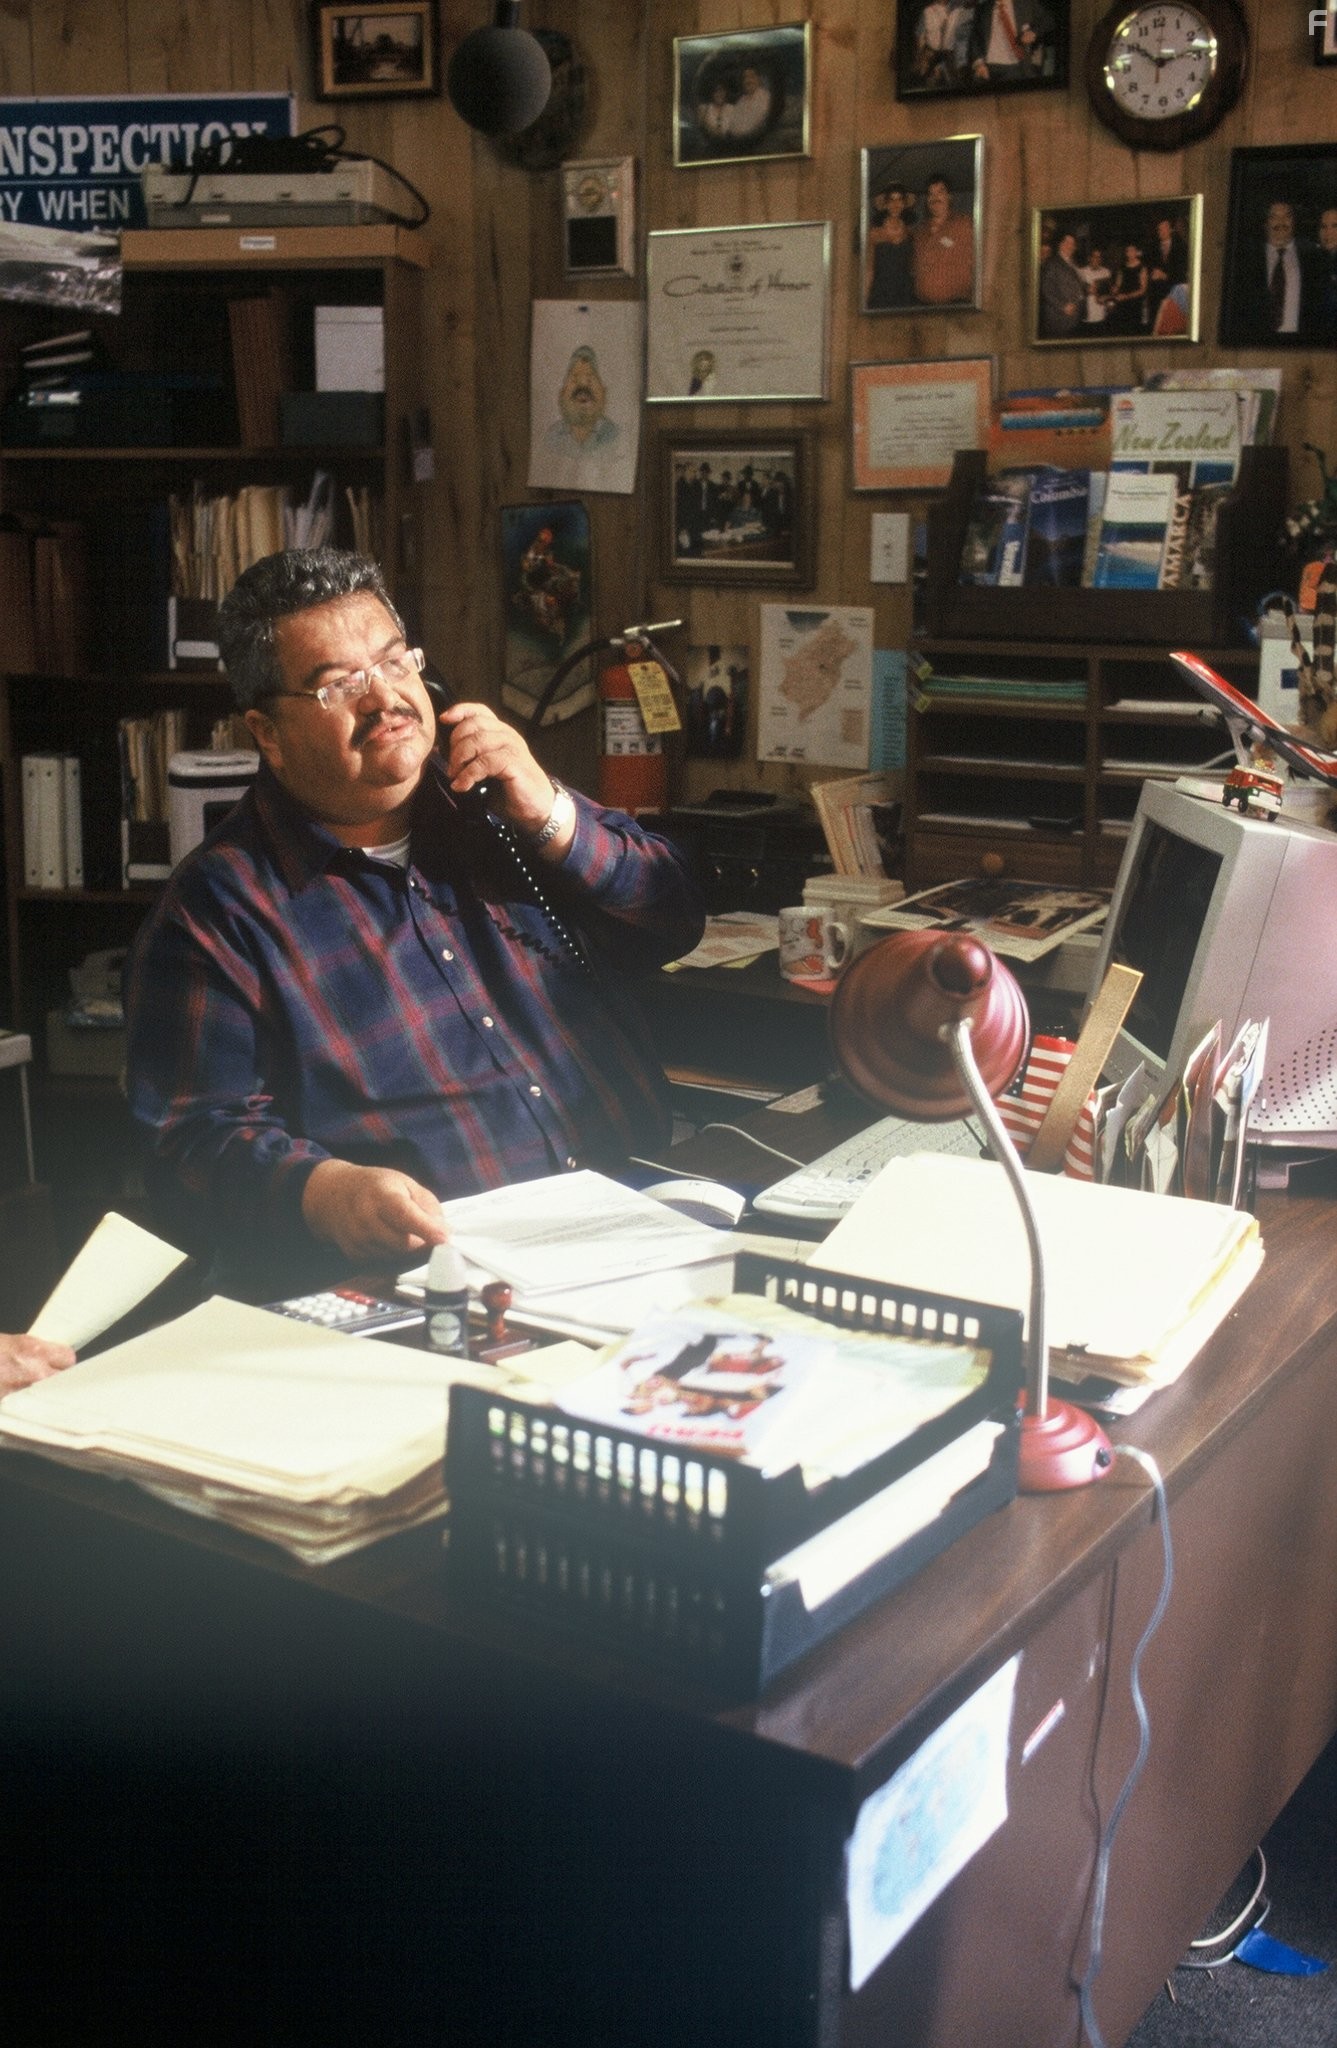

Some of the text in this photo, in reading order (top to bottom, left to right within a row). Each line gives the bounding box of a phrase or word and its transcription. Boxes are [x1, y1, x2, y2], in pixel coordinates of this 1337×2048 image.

[1153, 17, 1166, 28] 12
[1139, 26, 1148, 36] 11
[1186, 30, 1196, 42] 2
[1187, 71, 1196, 82] 4
[1128, 82, 1138, 93] 8
[1141, 94, 1150, 104] 7
[1174, 88, 1185, 99] 5
[1158, 96, 1169, 107] 6
[38, 189, 130, 220] WHEN
[1112, 421, 1237, 451] New Zealand
